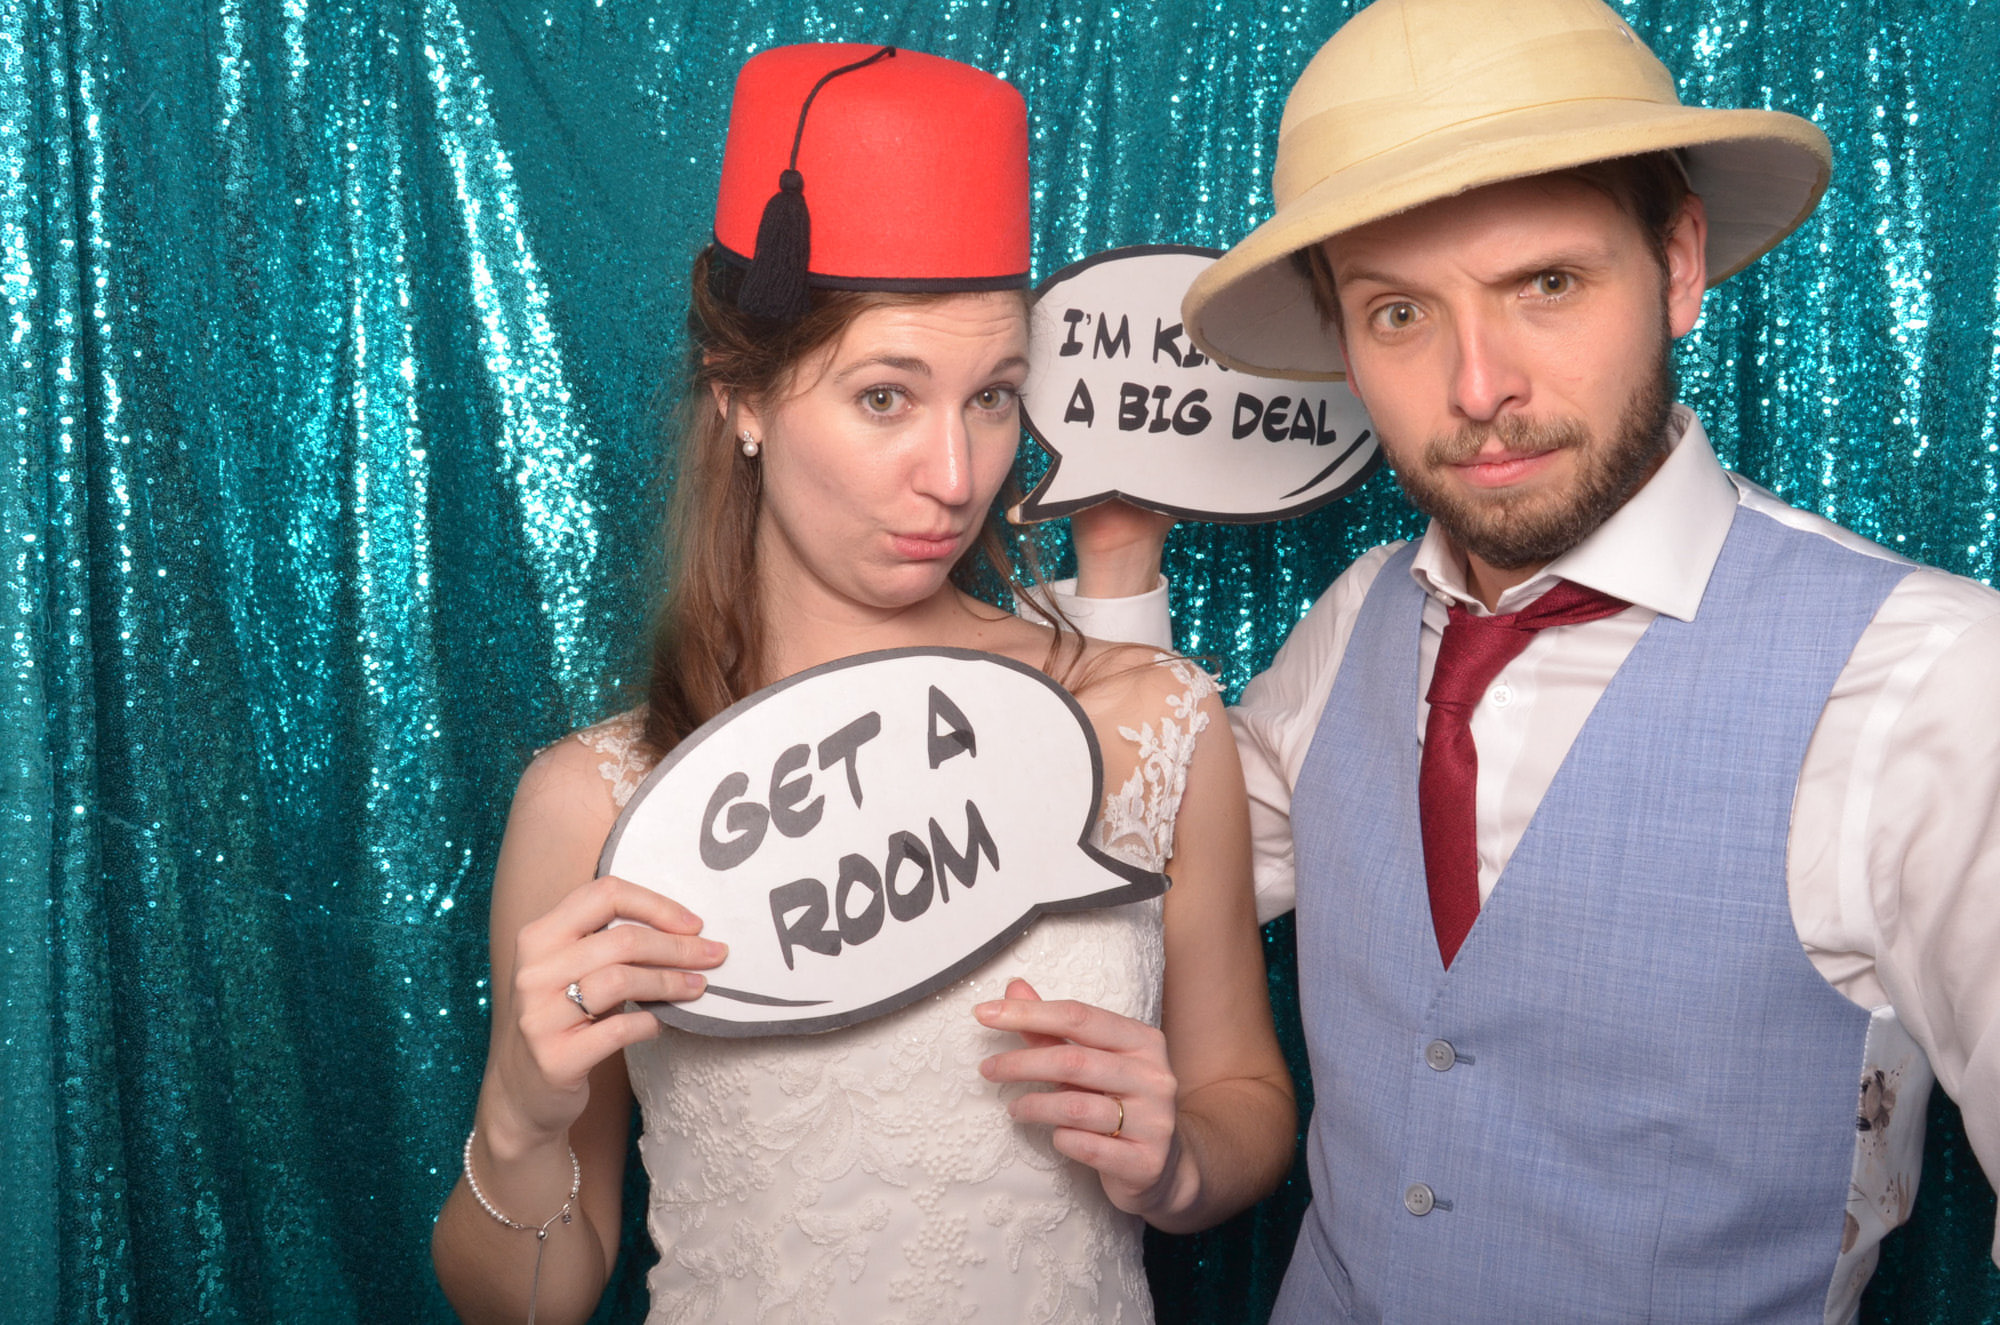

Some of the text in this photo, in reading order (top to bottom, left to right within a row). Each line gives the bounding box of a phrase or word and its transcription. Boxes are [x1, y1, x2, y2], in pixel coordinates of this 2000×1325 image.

[1059, 308, 1131, 360] I'M
[1064, 378, 1337, 446] A BIG DEAL
[699, 684, 977, 871] GET A
[769, 799, 1000, 970] ROOM
